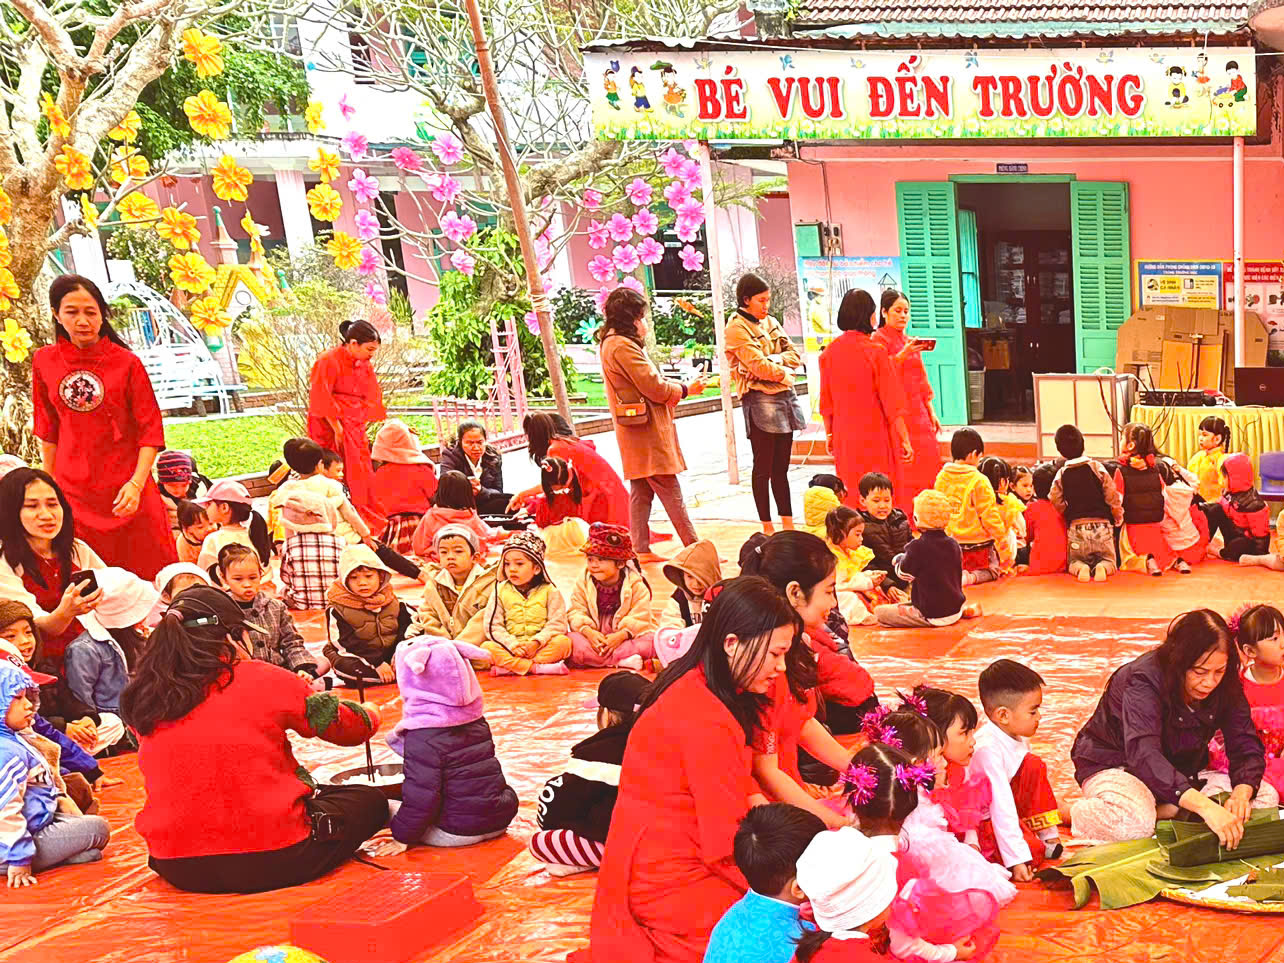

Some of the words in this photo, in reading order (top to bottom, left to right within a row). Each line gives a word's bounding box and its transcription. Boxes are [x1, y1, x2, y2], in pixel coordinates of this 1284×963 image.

[694, 65, 750, 120] BÉ
[767, 76, 846, 120] VUI
[866, 54, 954, 120] ĐẾN
[972, 60, 1146, 119] TRƯỜNG
